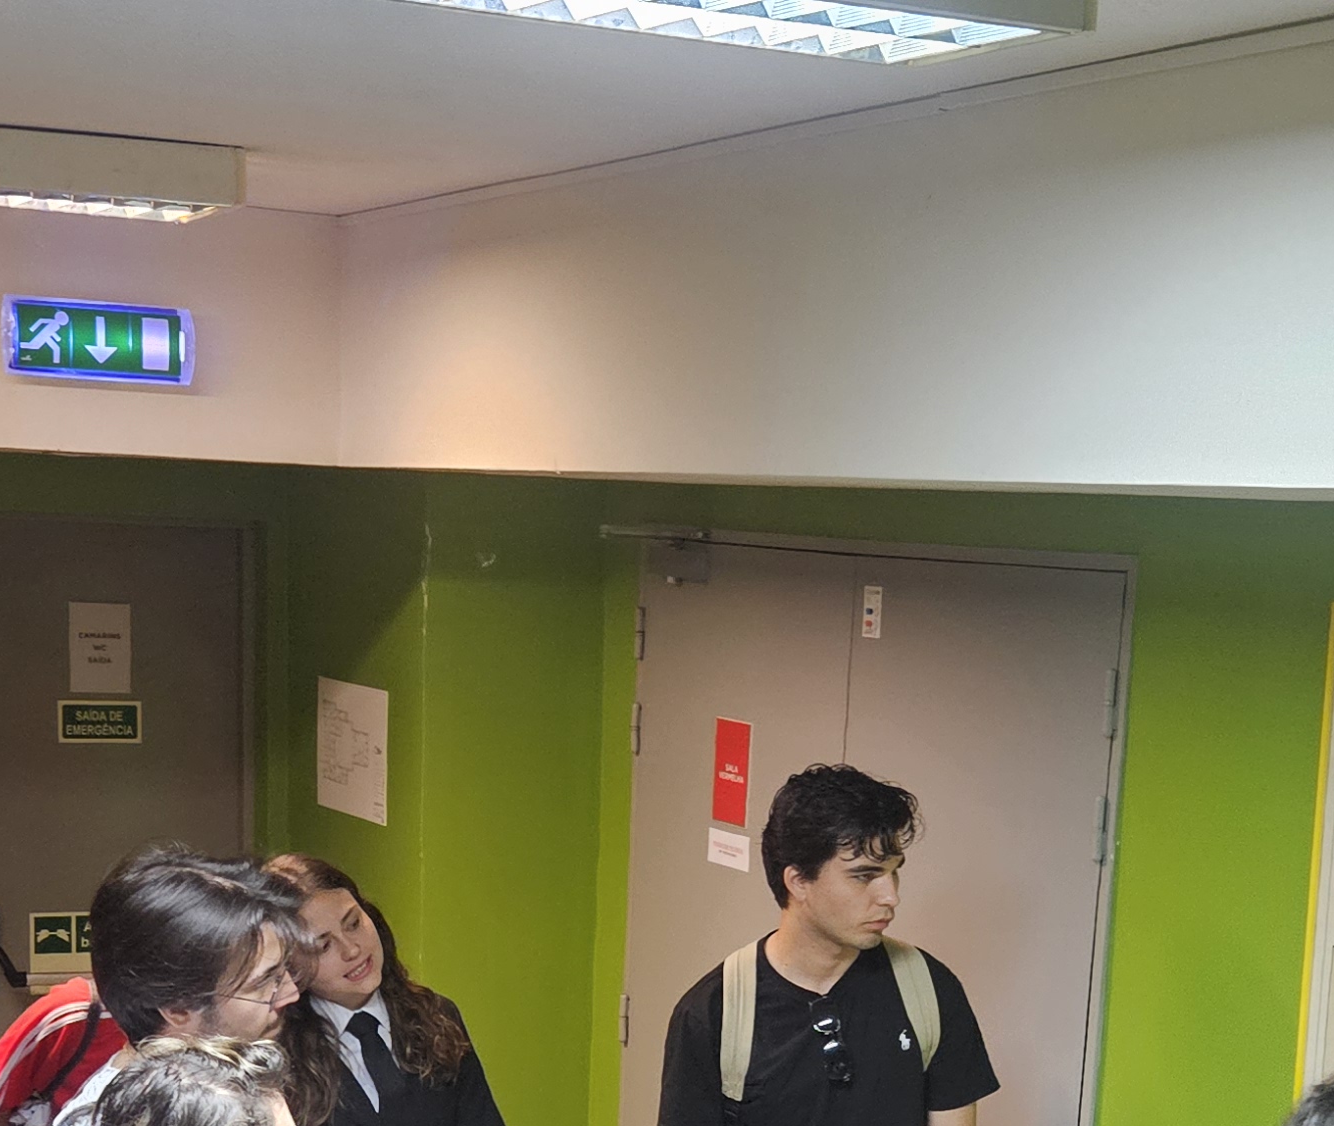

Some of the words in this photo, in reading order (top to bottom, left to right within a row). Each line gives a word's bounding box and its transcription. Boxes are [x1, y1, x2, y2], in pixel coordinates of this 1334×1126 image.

[92, 644, 107, 652] WC
[75, 709, 107, 721] SAÍDA
[109, 710, 124, 721] DE
[66, 722, 135, 736] EMERGÊNCIA
